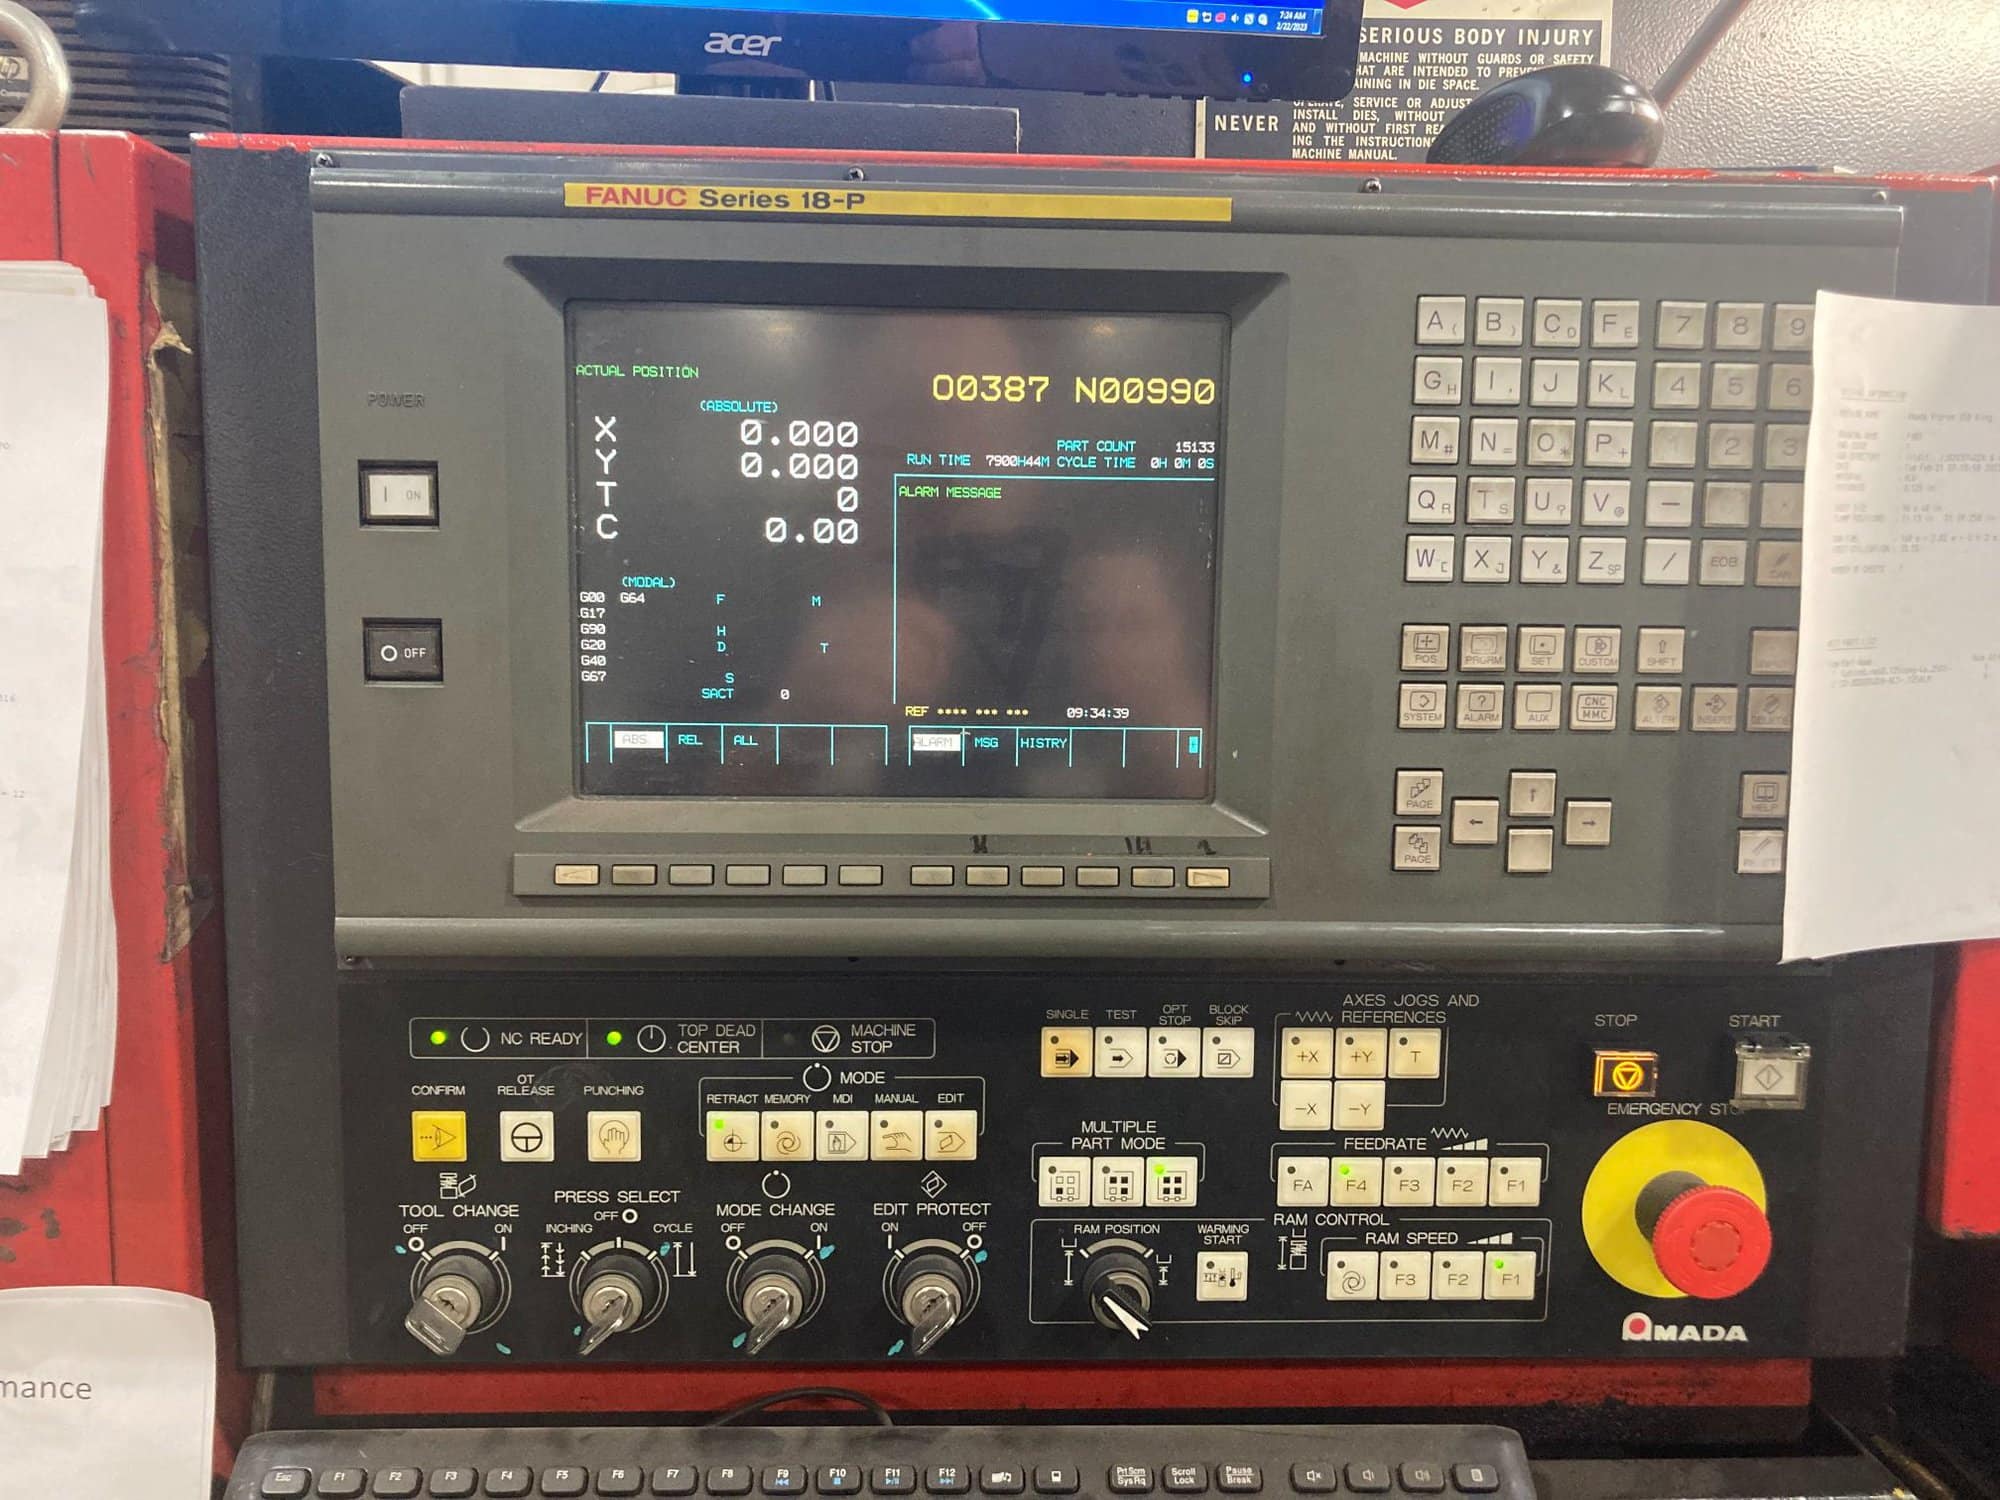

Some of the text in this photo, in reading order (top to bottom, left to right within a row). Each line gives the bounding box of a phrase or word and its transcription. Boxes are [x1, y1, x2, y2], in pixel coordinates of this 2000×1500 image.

[1293, 11, 1306, 20] AM
[1359, 26, 1594, 46] SERIOUS BODY INJURY
[703, 32, 783, 57] acer
[1359, 51, 1544, 65] MACHINE WITHOUT GUARDS OR
[1383, 65, 1491, 78] ARE INTENDED TO
[1399, 78, 1480, 91] IN DIE SPACE.
[1353, 97, 1422, 109] SERVICE OR
[1293, 110, 1445, 123] INSTALL DIES, WITHOUT
[1214, 115, 1280, 131] NEVER
[1292, 123, 1417, 134] AND WITHOUT FIRST
[1323, 135, 1345, 147] THE
[1291, 148, 1398, 161] MACHINE MANUAL.
[584, 186, 866, 210] FANUC Series 18-P
[575, 364, 700, 379] ACTUAL POSITION
[1074, 375, 1217, 405] N00990
[367, 392, 426, 408] POWER
[699, 399, 779, 414] (ABSOLUTE)
[593, 415, 859, 448] X 0.000
[1056, 439, 1216, 453] PART COUNT 15133
[594, 447, 859, 480] Y 0.000
[906, 453, 1136, 469] RUN TIME 7900H44M CYCLE TIME
[595, 480, 618, 508] T
[898, 486, 1002, 498] ALARM MESSAGE
[595, 513, 859, 545] C 0.00
[1710, 556, 1738, 568] EOB
[621, 576, 676, 589] (MODAL)
[579, 591, 646, 604] G00 G64
[579, 607, 606, 619] G17
[580, 623, 606, 635] G90
[580, 639, 607, 651] G20
[404, 647, 426, 659] OFF
[580, 655, 607, 666] G40
[1414, 655, 1438, 664] POS
[1531, 656, 1553, 666] SET
[581, 670, 607, 682] G67
[701, 688, 735, 700] SACT
[905, 705, 1130, 719] REF 09:34:39
[1403, 713, 1442, 722] SYSTEM
[1463, 713, 1500, 722] ALARM
[677, 734, 759, 746] REL ALL
[973, 736, 1068, 750] MSG HISTRY
[1406, 799, 1433, 810] PAGE
[1404, 854, 1432, 865] PAGE
[1342, 994, 1480, 1007] AXES JOGS AND
[1046, 1009, 1089, 1020] SINGLE
[1106, 1010, 1138, 1020] TEST
[1162, 1004, 1189, 1015] OPT
[1208, 1004, 1249, 1015] BLOCK
[1159, 1015, 1192, 1026] STOP
[1215, 1015, 1243, 1026] SKIP
[1341, 1010, 1447, 1024] REFERENCES
[1594, 1013, 1639, 1029] STOP
[1728, 1015, 1782, 1029] START
[678, 1024, 756, 1038] TOP DEAD
[850, 1024, 917, 1038] MACHINE
[500, 1031, 584, 1046] NC READY
[677, 1040, 741, 1055] CENTER
[850, 1040, 893, 1054] STOP
[516, 1074, 535, 1085] OT
[839, 1071, 886, 1085] MODE
[411, 1085, 466, 1096] CONFIRM
[497, 1085, 555, 1096] RELEASE
[583, 1085, 645, 1096] PUNCHING
[706, 1094, 759, 1105] RETRACT
[764, 1094, 812, 1105] MEMORY
[832, 1093, 854, 1105] MDI
[874, 1093, 919, 1105] MANUAL
[937, 1093, 965, 1104] EDIT
[1607, 1102, 1703, 1116] EMERGENCY
[1081, 1120, 1157, 1134] MULTIPLE
[1071, 1137, 1166, 1150] PART MODE
[1343, 1137, 1428, 1151] FEEDRATE
[1293, 1179, 1314, 1192] FA
[1346, 1179, 1367, 1192] F4
[1399, 1179, 1421, 1192] F3
[1452, 1179, 1474, 1192] F2
[1507, 1179, 1526, 1192] F1
[554, 1191, 681, 1204] PRESS SELECT
[399, 1204, 520, 1218] TOOL CHANGE
[716, 1203, 836, 1216] MODE CHANGE
[873, 1203, 992, 1216] EDIT PROTECT
[1273, 1213, 1390, 1227] RAM CONTROL
[403, 1223, 429, 1234] OFF
[494, 1223, 513, 1234] ON
[545, 1223, 593, 1234] INCHING
[653, 1223, 694, 1234] CYCLE
[720, 1223, 745, 1233] OFF
[810, 1222, 829, 1233] ON
[881, 1222, 899, 1233] ON
[962, 1222, 987, 1233] OFF
[1073, 1224, 1161, 1235] RAM POSITION
[1197, 1224, 1250, 1234] WARMING
[1203, 1235, 1243, 1246] START
[1365, 1232, 1459, 1245] RAM SPEED
[1395, 1274, 1417, 1286] F3
[1447, 1274, 1469, 1286] F2
[1502, 1274, 1521, 1286] F1
[666, 1469, 681, 1479] F7
[829, 1469, 847, 1478] F10
[938, 1468, 956, 1477] F12
[1171, 1467, 1196, 1476] Scroll
[1174, 1476, 1195, 1485] Lock
